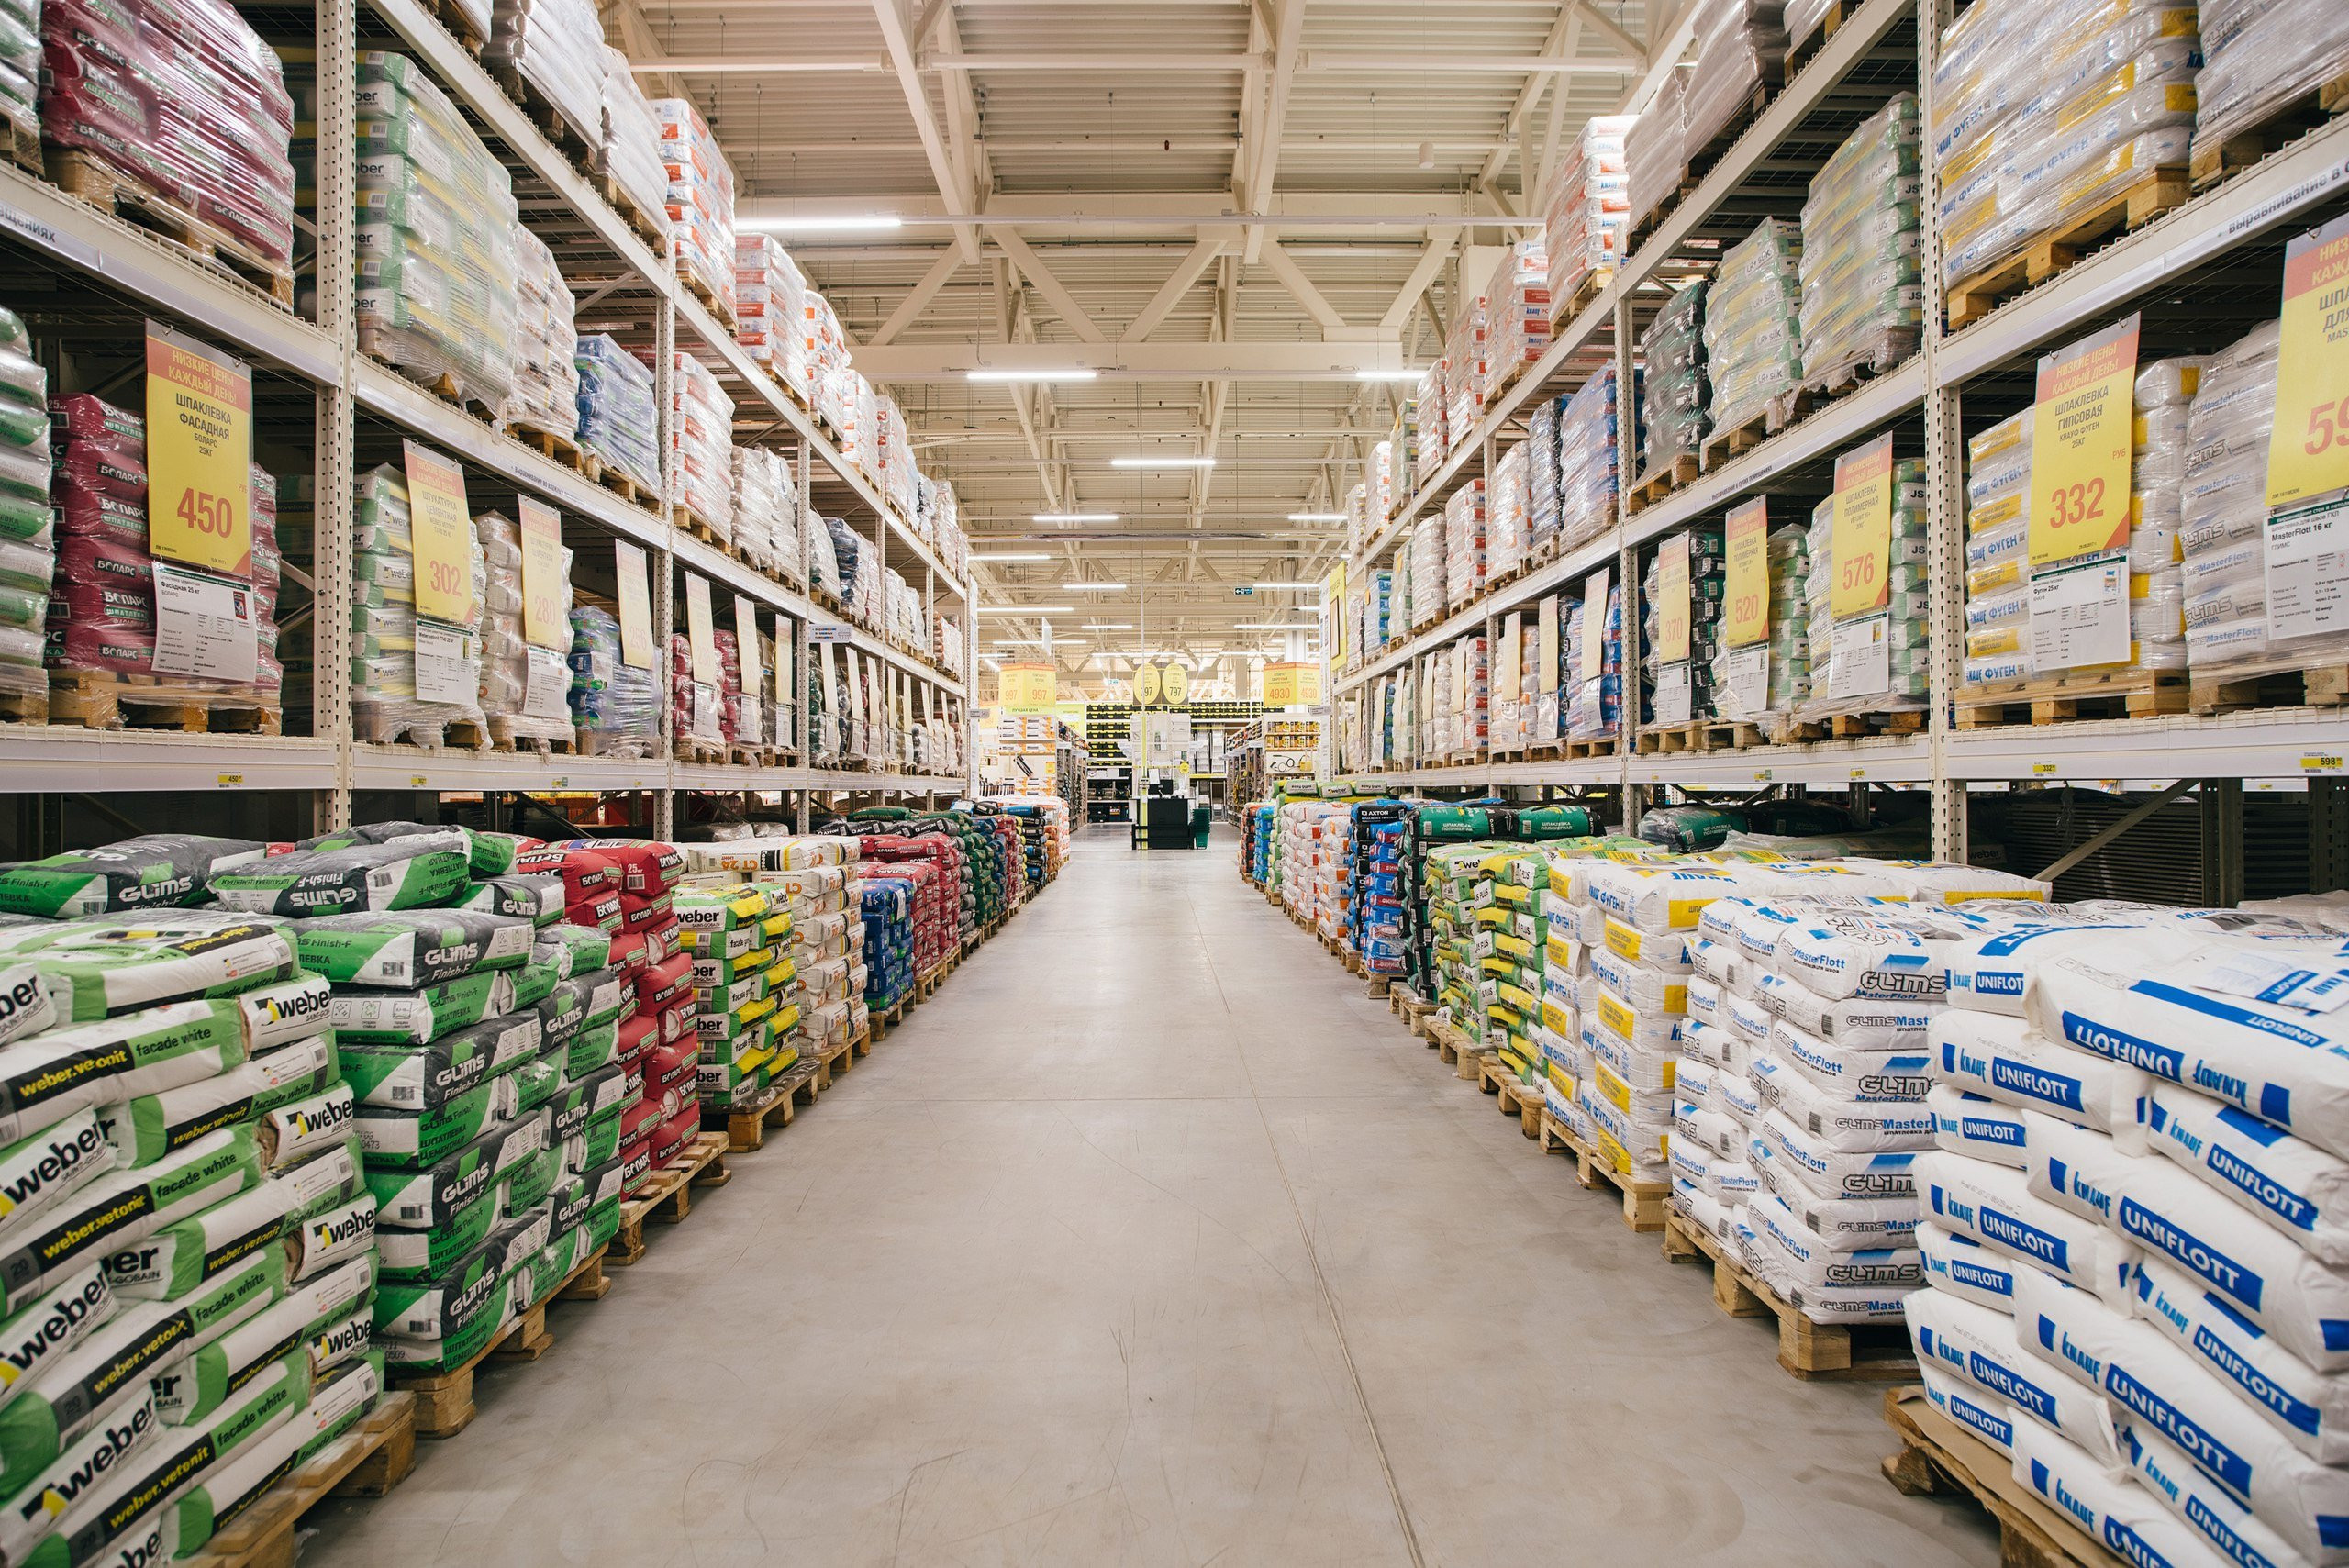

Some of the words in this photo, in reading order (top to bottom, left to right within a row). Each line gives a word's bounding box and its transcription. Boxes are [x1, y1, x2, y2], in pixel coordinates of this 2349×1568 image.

[173, 350, 210, 375] НИЗКИЕ
[212, 367, 233, 386] ЦЕНЫ
[2057, 356, 2090, 378] НИЗКИЕ
[2092, 342, 2117, 363] ЦЕНЫ
[169, 366, 211, 393] КАЖДЫЙ
[2053, 369, 2090, 395] КАЖДЫЙ
[176, 393, 231, 425] ШПАКЛЕВКА
[2055, 385, 2109, 417] ШПАКЛЕВКА
[180, 413, 229, 440] ФАСАДНАЯ
[2058, 404, 2103, 431] ГИПСОВАЯ
[195, 433, 217, 448] БОЛАРС
[2060, 429, 2079, 441] КНАУФ
[2080, 421, 2099, 434] ФУГЕН
[2072, 437, 2085, 448] 25КГ
[199, 446, 212, 456] 25КГ
[2113, 448, 2126, 459] РУБ
[101, 464, 138, 484] БОЛАРС
[1991, 466, 2021, 489] ФУГЕН
[1910, 490, 1924, 498] JS
[2050, 477, 2104, 528] 332
[101, 497, 146, 519] БОЛАРС
[177, 487, 232, 539] 450
[1988, 535, 2018, 554] ФУГЕН
[2272, 526, 2311, 541] MasterFlott
[1912, 546, 1925, 554] JS
[98, 560, 135, 576] БОЛАРС
[429, 560, 462, 596] 302
[1842, 552, 1874, 590] 576
[161, 581, 187, 593] Фасадная
[105, 591, 147, 607] БОЛАРС
[1736, 595, 1758, 624] 520
[1989, 600, 2020, 618] ФУГЕН
[1666, 617, 1682, 642] 370
[2206, 628, 2262, 642] MasterFlott
[103, 646, 138, 659] БОЛАРС
[1985, 665, 2016, 679] ФУГЕН
[1005, 690, 1018, 700] 997
[1032, 690, 1047, 700] 997
[1170, 687, 1181, 696] 797
[1270, 688, 1290, 699] 4930
[2320, 758, 2335, 766] 598
[11, 879, 50, 888] Finish-F
[297, 873, 343, 888] Finish-F
[1600, 890, 1620, 911] ФУГЕН
[312, 940, 351, 949] Finish-F
[1741, 932, 1775, 952] MasterFlott
[1794, 948, 1845, 969] MasterFlott
[431, 964, 470, 981] Finish-F
[1599, 966, 1618, 987] ФУГЕН
[136, 1038, 179, 1057] facade
[181, 1029, 212, 1044] white
[1596, 1040, 1614, 1063] ФУГЕН
[2076, 1024, 2173, 1074] UNIFLOTT
[1793, 1042, 1842, 1073] MasterFlott
[1959, 1048, 1987, 1083] KNAUF
[1995, 1062, 2068, 1100] UNIFLOTT
[287, 1082, 310, 1099] white
[444, 1075, 480, 1100] Finish-F
[1593, 1105, 1613, 1132] ФУГЕН
[1964, 1120, 2015, 1140] UNIFLOTT
[420, 1125, 467, 1148] ШПАТЛЕВКА
[1675, 1152, 1706, 1174] MasterFlott
[1782, 1137, 1827, 1172] MasterFlott
[157, 1169, 200, 1198] facade
[204, 1153, 237, 1175] white
[2169, 1118, 2203, 1157] KNAUF
[2212, 1148, 2304, 1221] UNIFLOTT
[450, 1187, 484, 1215] Finish-F
[208, 1225, 281, 1272] weber.vetonit
[314, 1195, 338, 1215] white
[1947, 1192, 1974, 1229] KNAUF
[1984, 1213, 2054, 1261] UNIFLOTT
[2125, 1207, 2240, 1291] UNIFLOTT
[1954, 1265, 2003, 1289] UNIFLOTT
[196, 1290, 235, 1321] facade
[237, 1272, 266, 1297] white
[457, 1292, 491, 1328] Finish-F
[2155, 1290, 2189, 1333] KNAUF
[2199, 1329, 2291, 1413] UNIFLOTT
[1938, 1334, 1965, 1373] KNAUF
[1975, 1359, 2043, 1413] UNIFLOTT
[2061, 1331, 2100, 1384] KNAUF
[2112, 1373, 2228, 1473] UNIFLOTT
[1952, 1399, 2007, 1440] UNIFLOTT
[111, 1446, 209, 1529] weber.vetonit
[218, 1413, 256, 1446] facade
[258, 1387, 287, 1415] white
[2146, 1455, 2179, 1502] KNAUF
[2056, 1478, 2095, 1532] KNAUF
